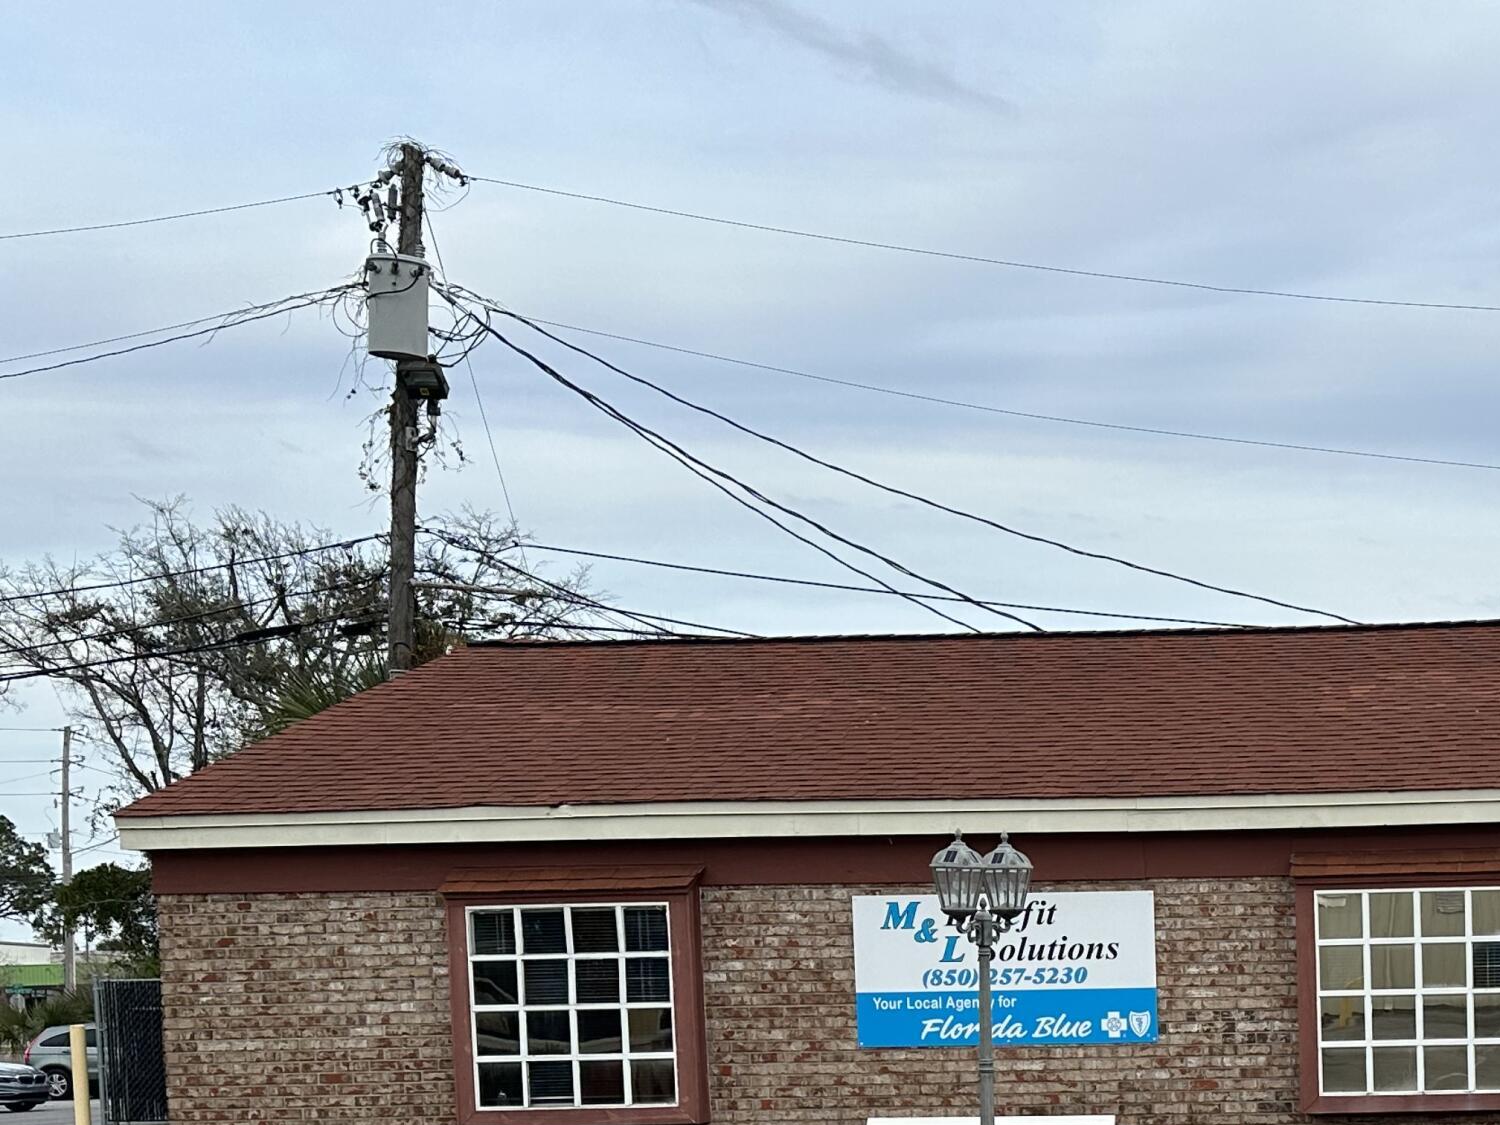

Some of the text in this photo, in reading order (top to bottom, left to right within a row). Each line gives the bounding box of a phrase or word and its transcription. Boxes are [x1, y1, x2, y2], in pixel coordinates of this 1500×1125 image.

[880, 901, 921, 929] M
[913, 917, 938, 943] &
[938, 935, 965, 963] L
[922, 966, 1088, 989] (850) 257-5230
[873, 997, 902, 1010] Your
[906, 996, 942, 1010] Local
[998, 994, 1017, 1009] for
[921, 1013, 1092, 1040] Florda Blue
